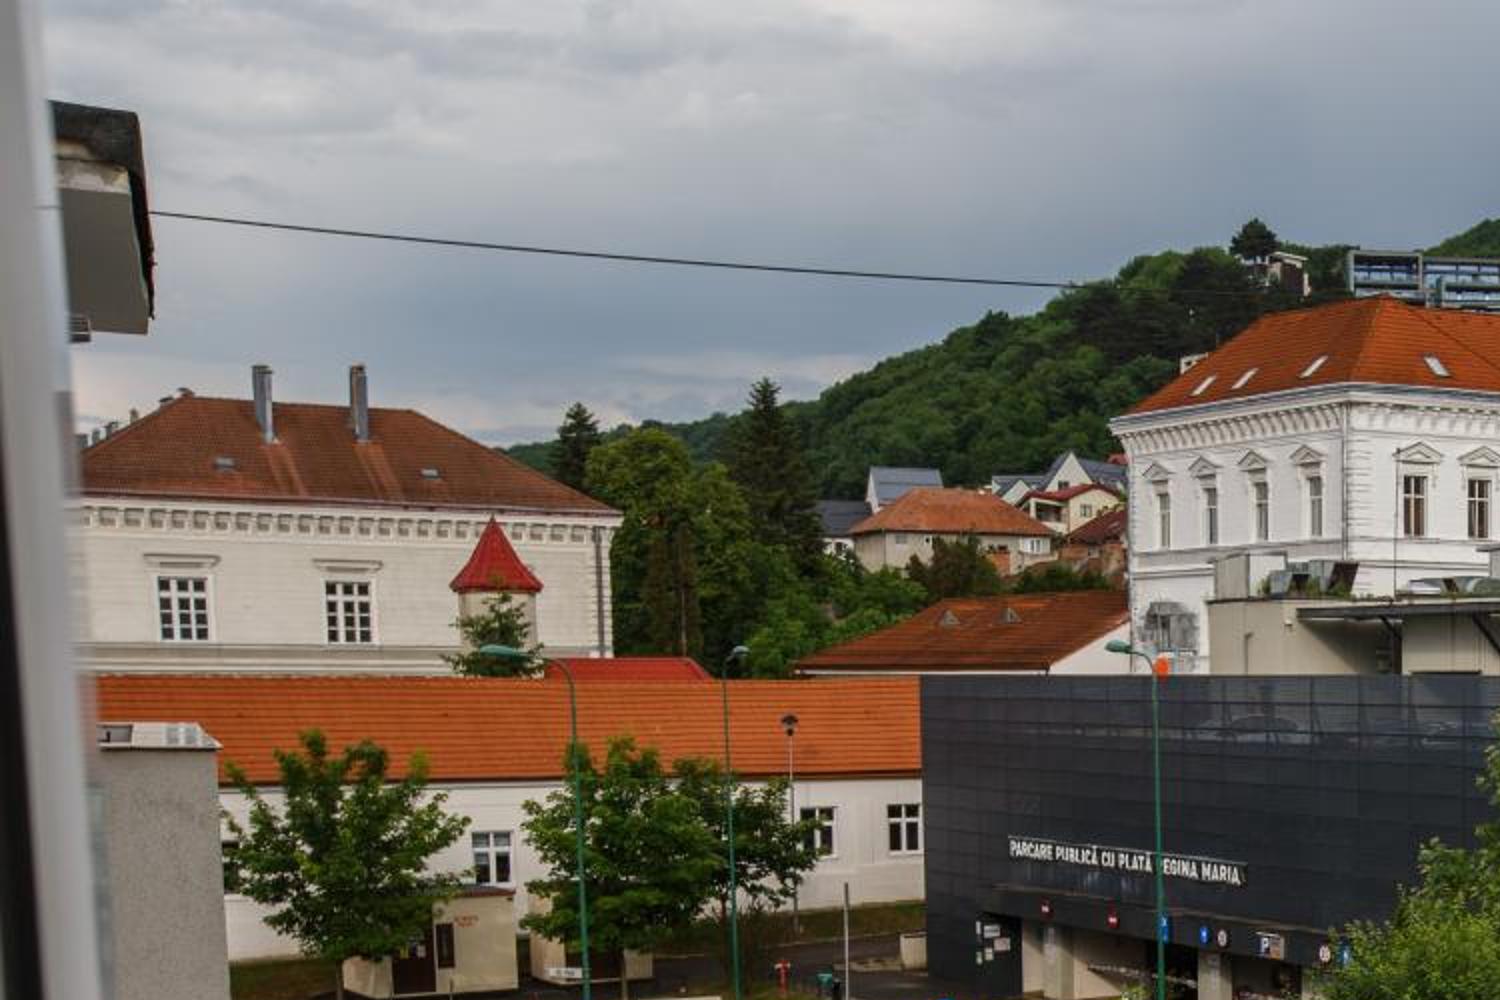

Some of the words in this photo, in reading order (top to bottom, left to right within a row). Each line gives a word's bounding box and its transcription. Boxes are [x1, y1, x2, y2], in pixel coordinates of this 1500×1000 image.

[1009, 839, 1053, 861] PARCARE
[1101, 851, 1115, 867] CU
[1159, 857, 1199, 879] EGINA
[1201, 862, 1242, 886] MARIA
